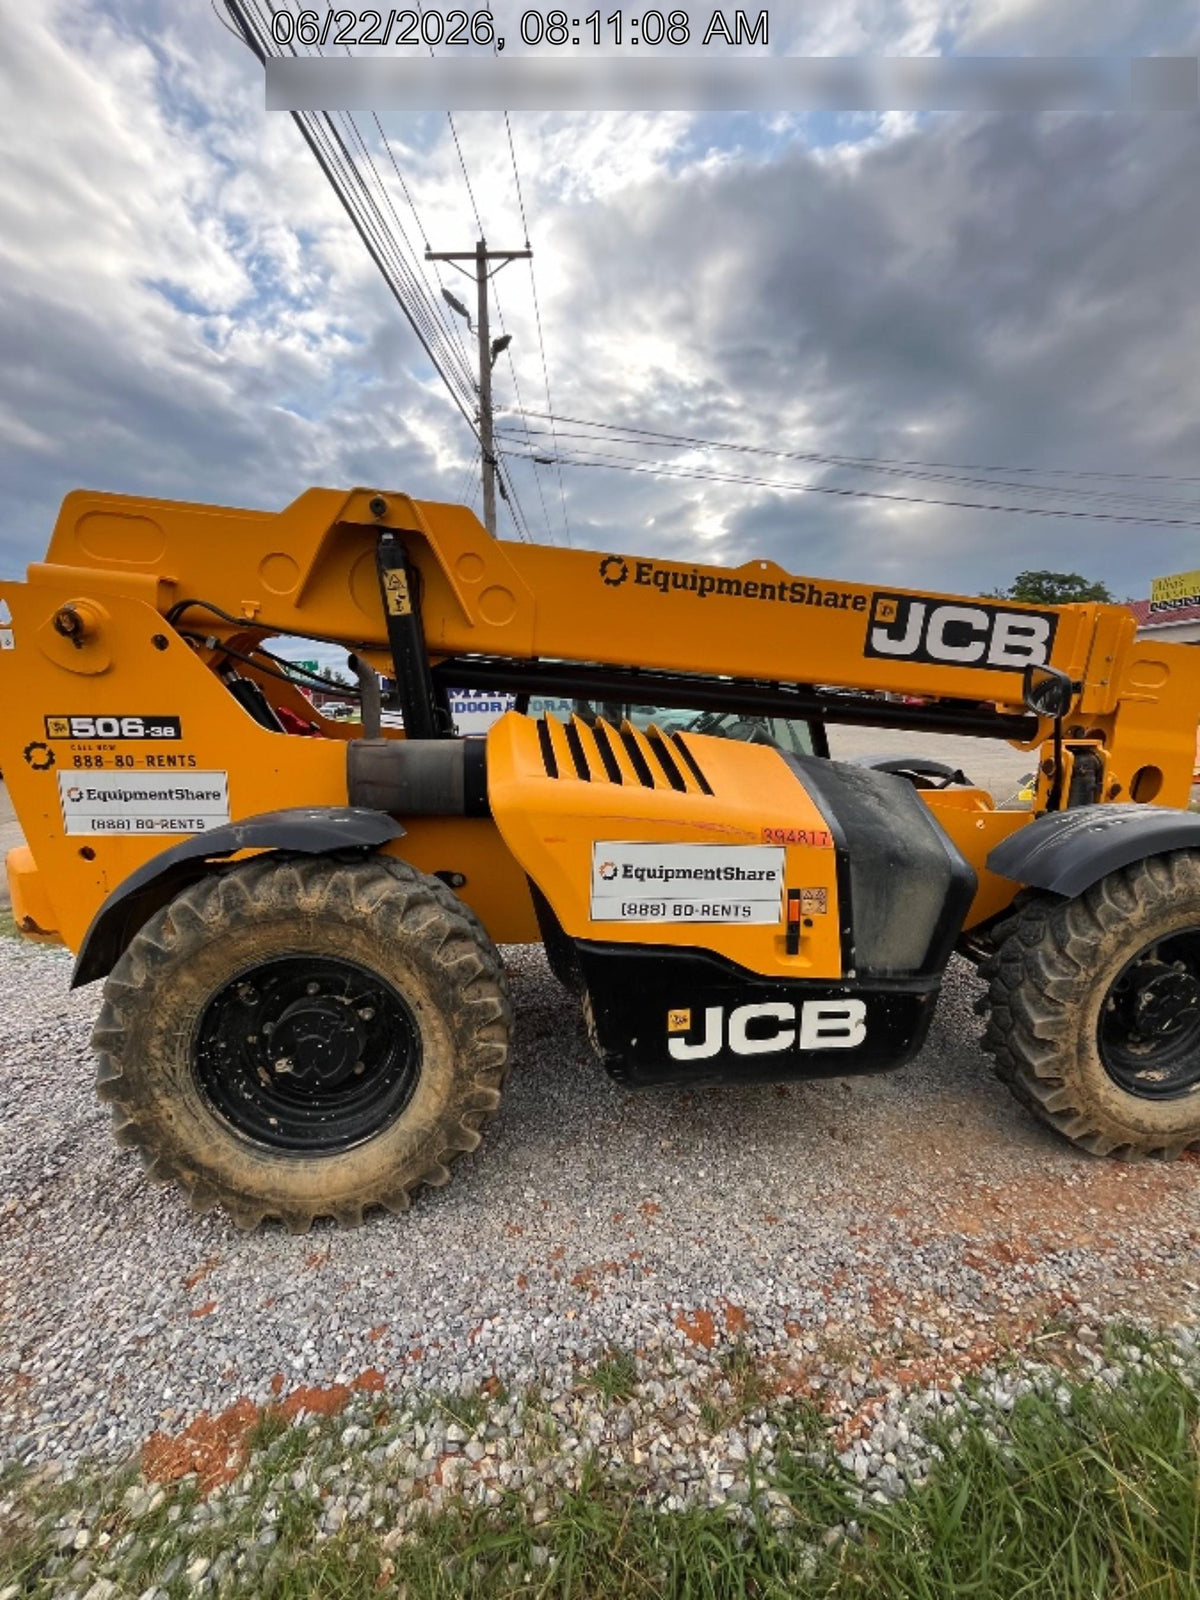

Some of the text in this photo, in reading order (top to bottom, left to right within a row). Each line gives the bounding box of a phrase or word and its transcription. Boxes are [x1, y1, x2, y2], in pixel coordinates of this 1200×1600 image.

[634, 561, 867, 612] EquipmentShare
[871, 602, 1050, 666] JCB
[450, 701, 502, 713] DOOR
[70, 717, 176, 738] 506-38
[73, 754, 197, 768] 888-80-RENTS
[86, 788, 221, 803] EquipmentShare
[763, 828, 828, 846] 394817
[622, 863, 776, 882] EquipmentShare
[668, 999, 867, 1060] JCB
